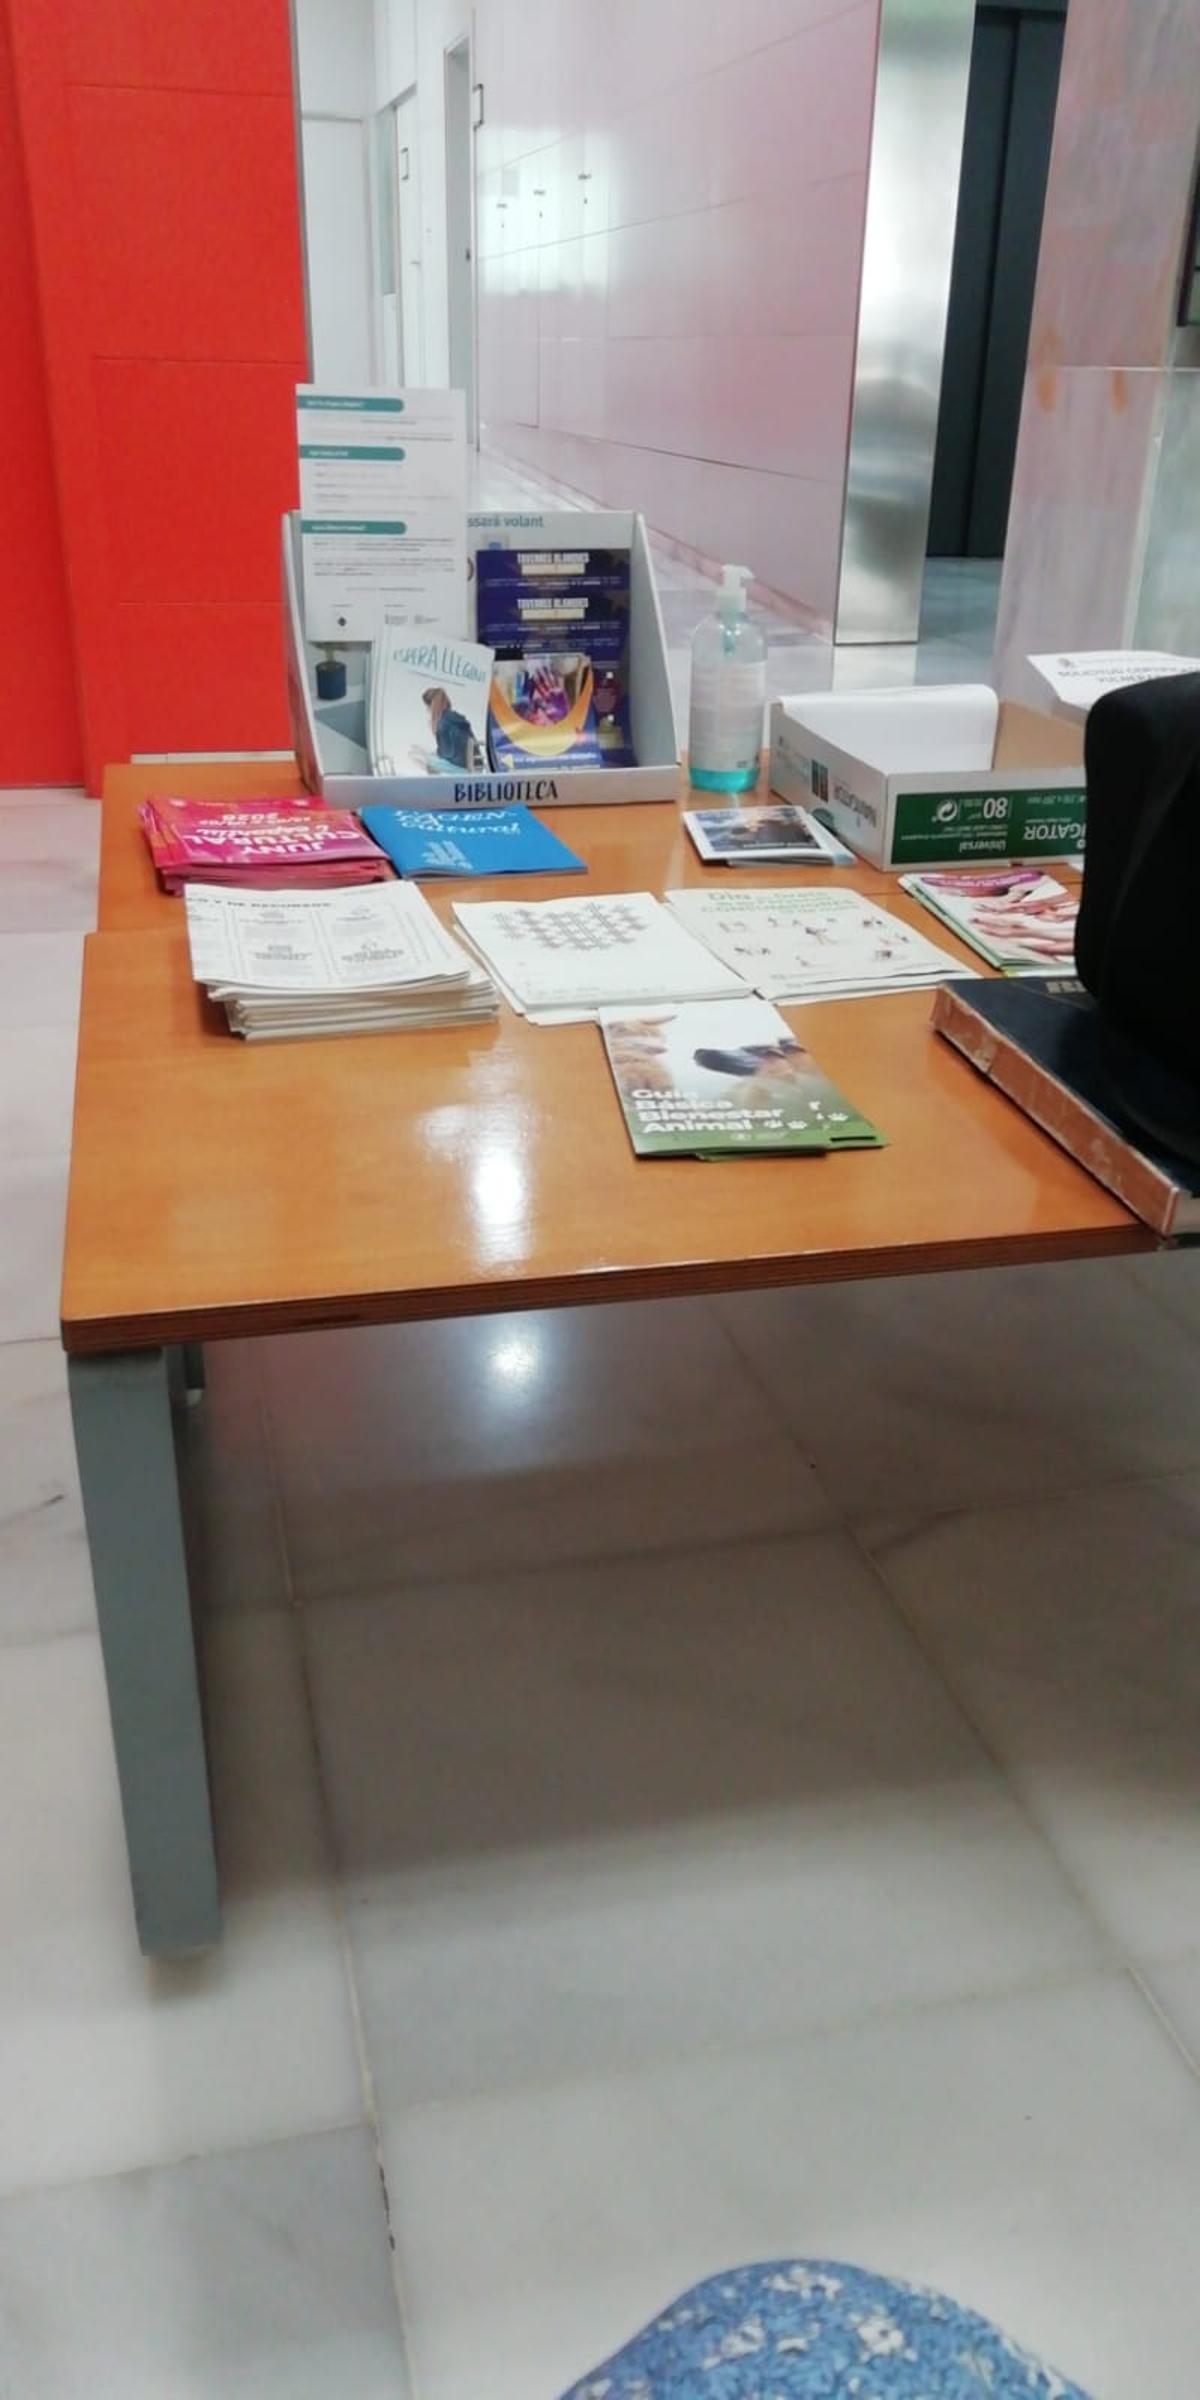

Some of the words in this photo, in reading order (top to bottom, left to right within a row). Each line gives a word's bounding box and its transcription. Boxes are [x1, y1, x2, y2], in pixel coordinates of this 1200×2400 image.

[504, 515, 544, 528] volant
[454, 779, 558, 803] BIBLIOTECA
[983, 797, 1009, 819] 80
[184, 830, 361, 846] CULTURAL
[241, 841, 324, 855] JUNY
[958, 839, 1007, 853] Universal
[639, 1108, 784, 1122] Bienestar
[643, 1119, 753, 1133] Animal
